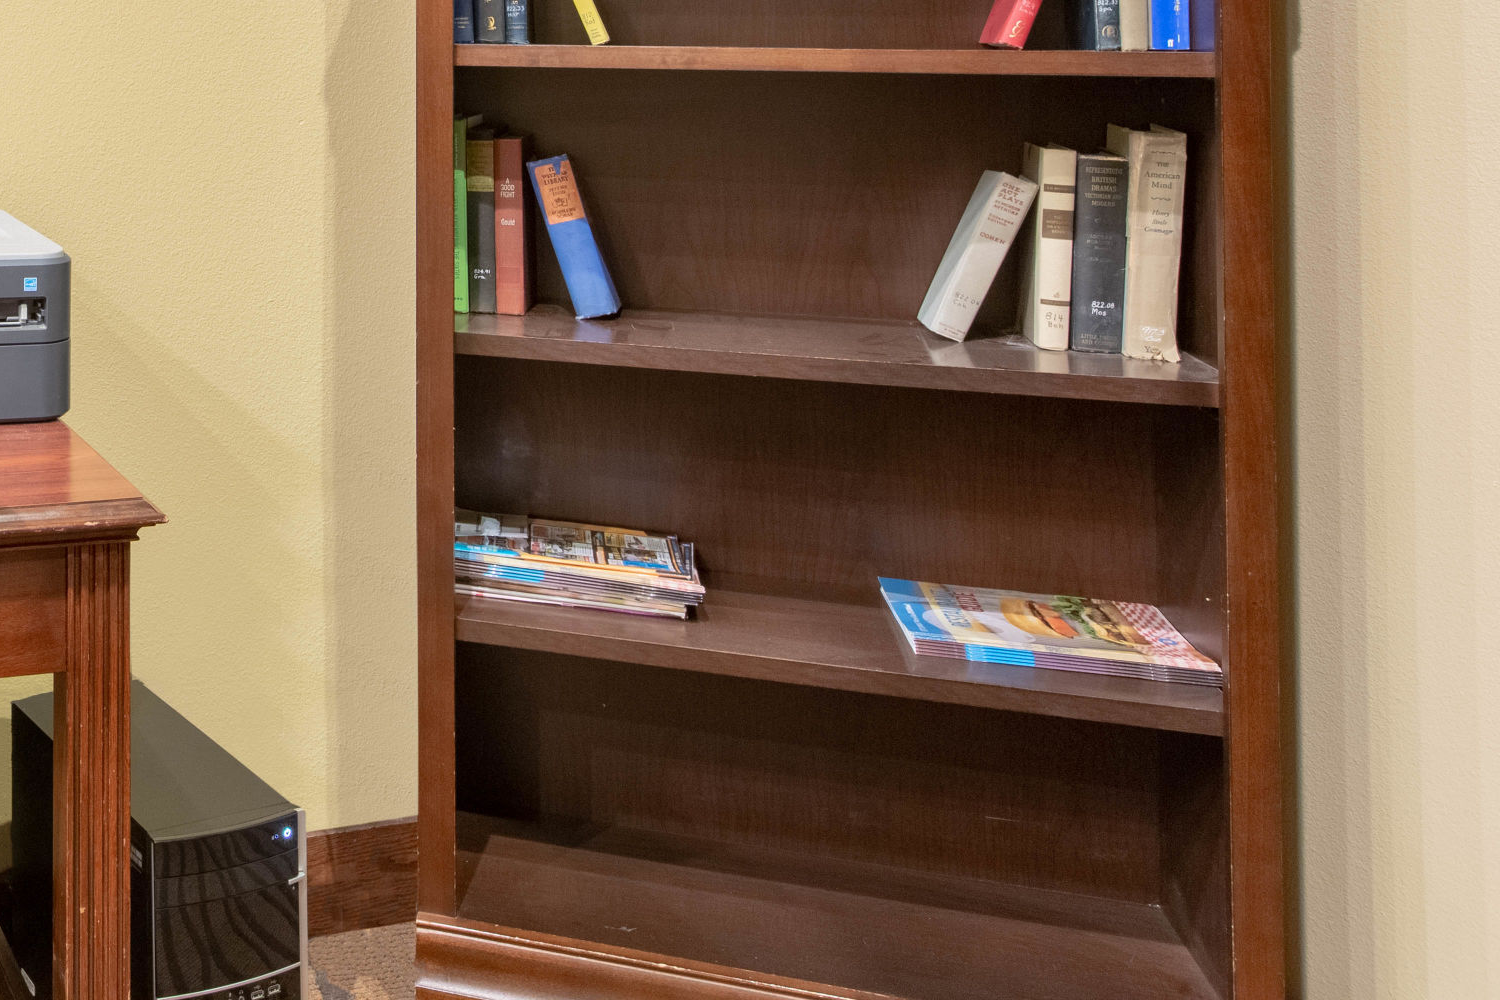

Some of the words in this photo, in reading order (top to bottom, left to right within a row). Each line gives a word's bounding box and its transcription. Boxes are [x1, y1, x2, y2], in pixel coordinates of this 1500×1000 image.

[1091, 176, 1117, 184] BRITISH
[1144, 171, 1181, 180] American
[543, 175, 569, 186] LIBRARY
[1151, 181, 1172, 189] Mind
[1002, 181, 1025, 193] ONE-
[1091, 184, 1117, 192] DRAMAS
[500, 191, 516, 199] FIGHT
[1000, 188, 1019, 198] ACT
[997, 192, 1024, 206] PLAYS
[500, 218, 516, 226] Gould
[979, 231, 1006, 245] COHEN
[1045, 311, 1064, 322] 814
[1091, 308, 1107, 316] Mos
[953, 591, 984, 613] GUIDE
